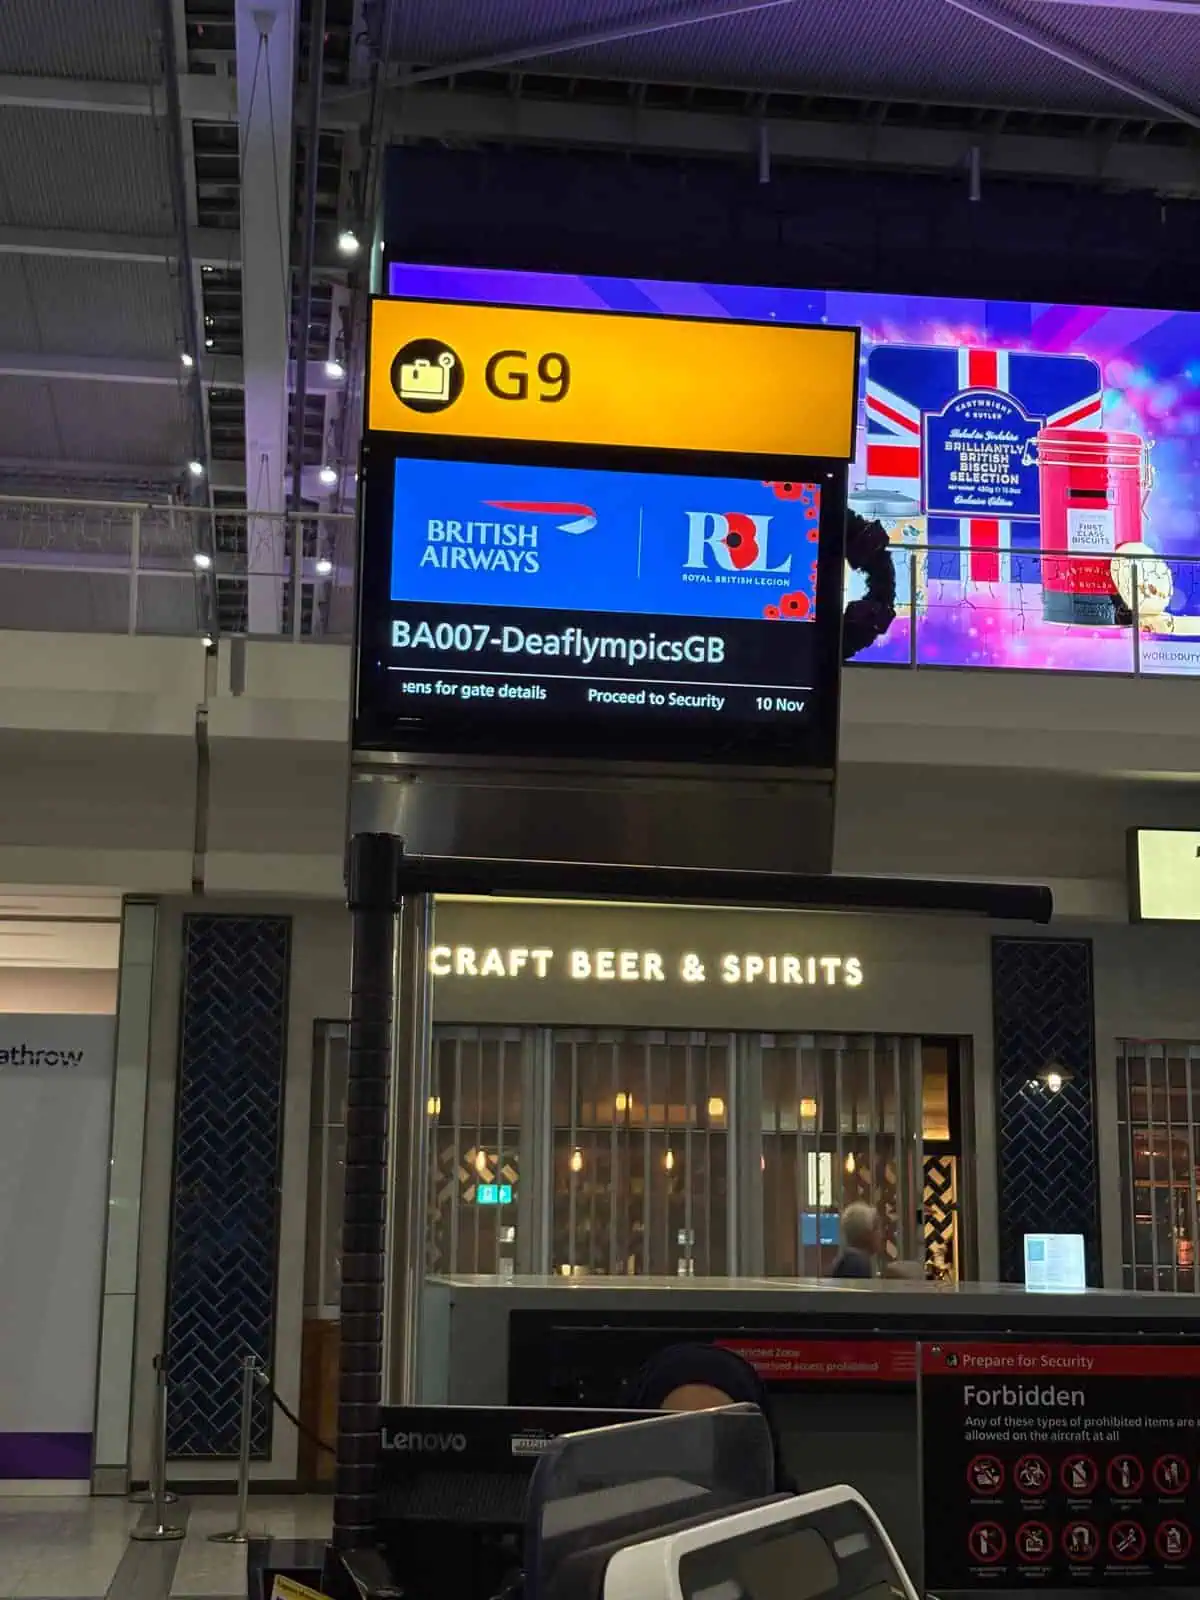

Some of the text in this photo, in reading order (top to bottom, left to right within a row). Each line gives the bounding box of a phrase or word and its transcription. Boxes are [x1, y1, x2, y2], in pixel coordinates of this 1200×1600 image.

[484, 350, 570, 403] G9
[944, 441, 1024, 454] BRILLIANTLY
[960, 452, 1009, 464] BRITISH
[960, 462, 1009, 474] BISCUIT
[950, 471, 1019, 485] SELECTION
[428, 519, 538, 548] BRITISH
[1071, 536, 1110, 545] BISCUITS
[419, 545, 540, 574] AIRWAYS
[682, 574, 790, 588] ROYAL BRITISH LEGION
[391, 620, 725, 665] BA007-DeaflympicsGB
[435, 680, 458, 695] for
[461, 684, 495, 699] gate
[498, 684, 548, 700] details
[588, 688, 804, 712] Proceed to Security 10 Nov
[428, 946, 864, 985] CRAFT BEER & SPIRITS
[963, 1354, 1094, 1370] Prepare for Security
[963, 1384, 1085, 1407] Forbidden
[965, 1416, 987, 1428] Any
[990, 1416, 1002, 1426] of
[1005, 1416, 1034, 1426] these
[1037, 1416, 1067, 1429] types
[1070, 1416, 1082, 1426] of
[1084, 1416, 1142, 1428] prohibited
[1145, 1416, 1174, 1427] items
[1176, 1418, 1195, 1427] are
[380, 1427, 467, 1452] Lenovo
[964, 1430, 1120, 1441] allowed on the aircraft at all
